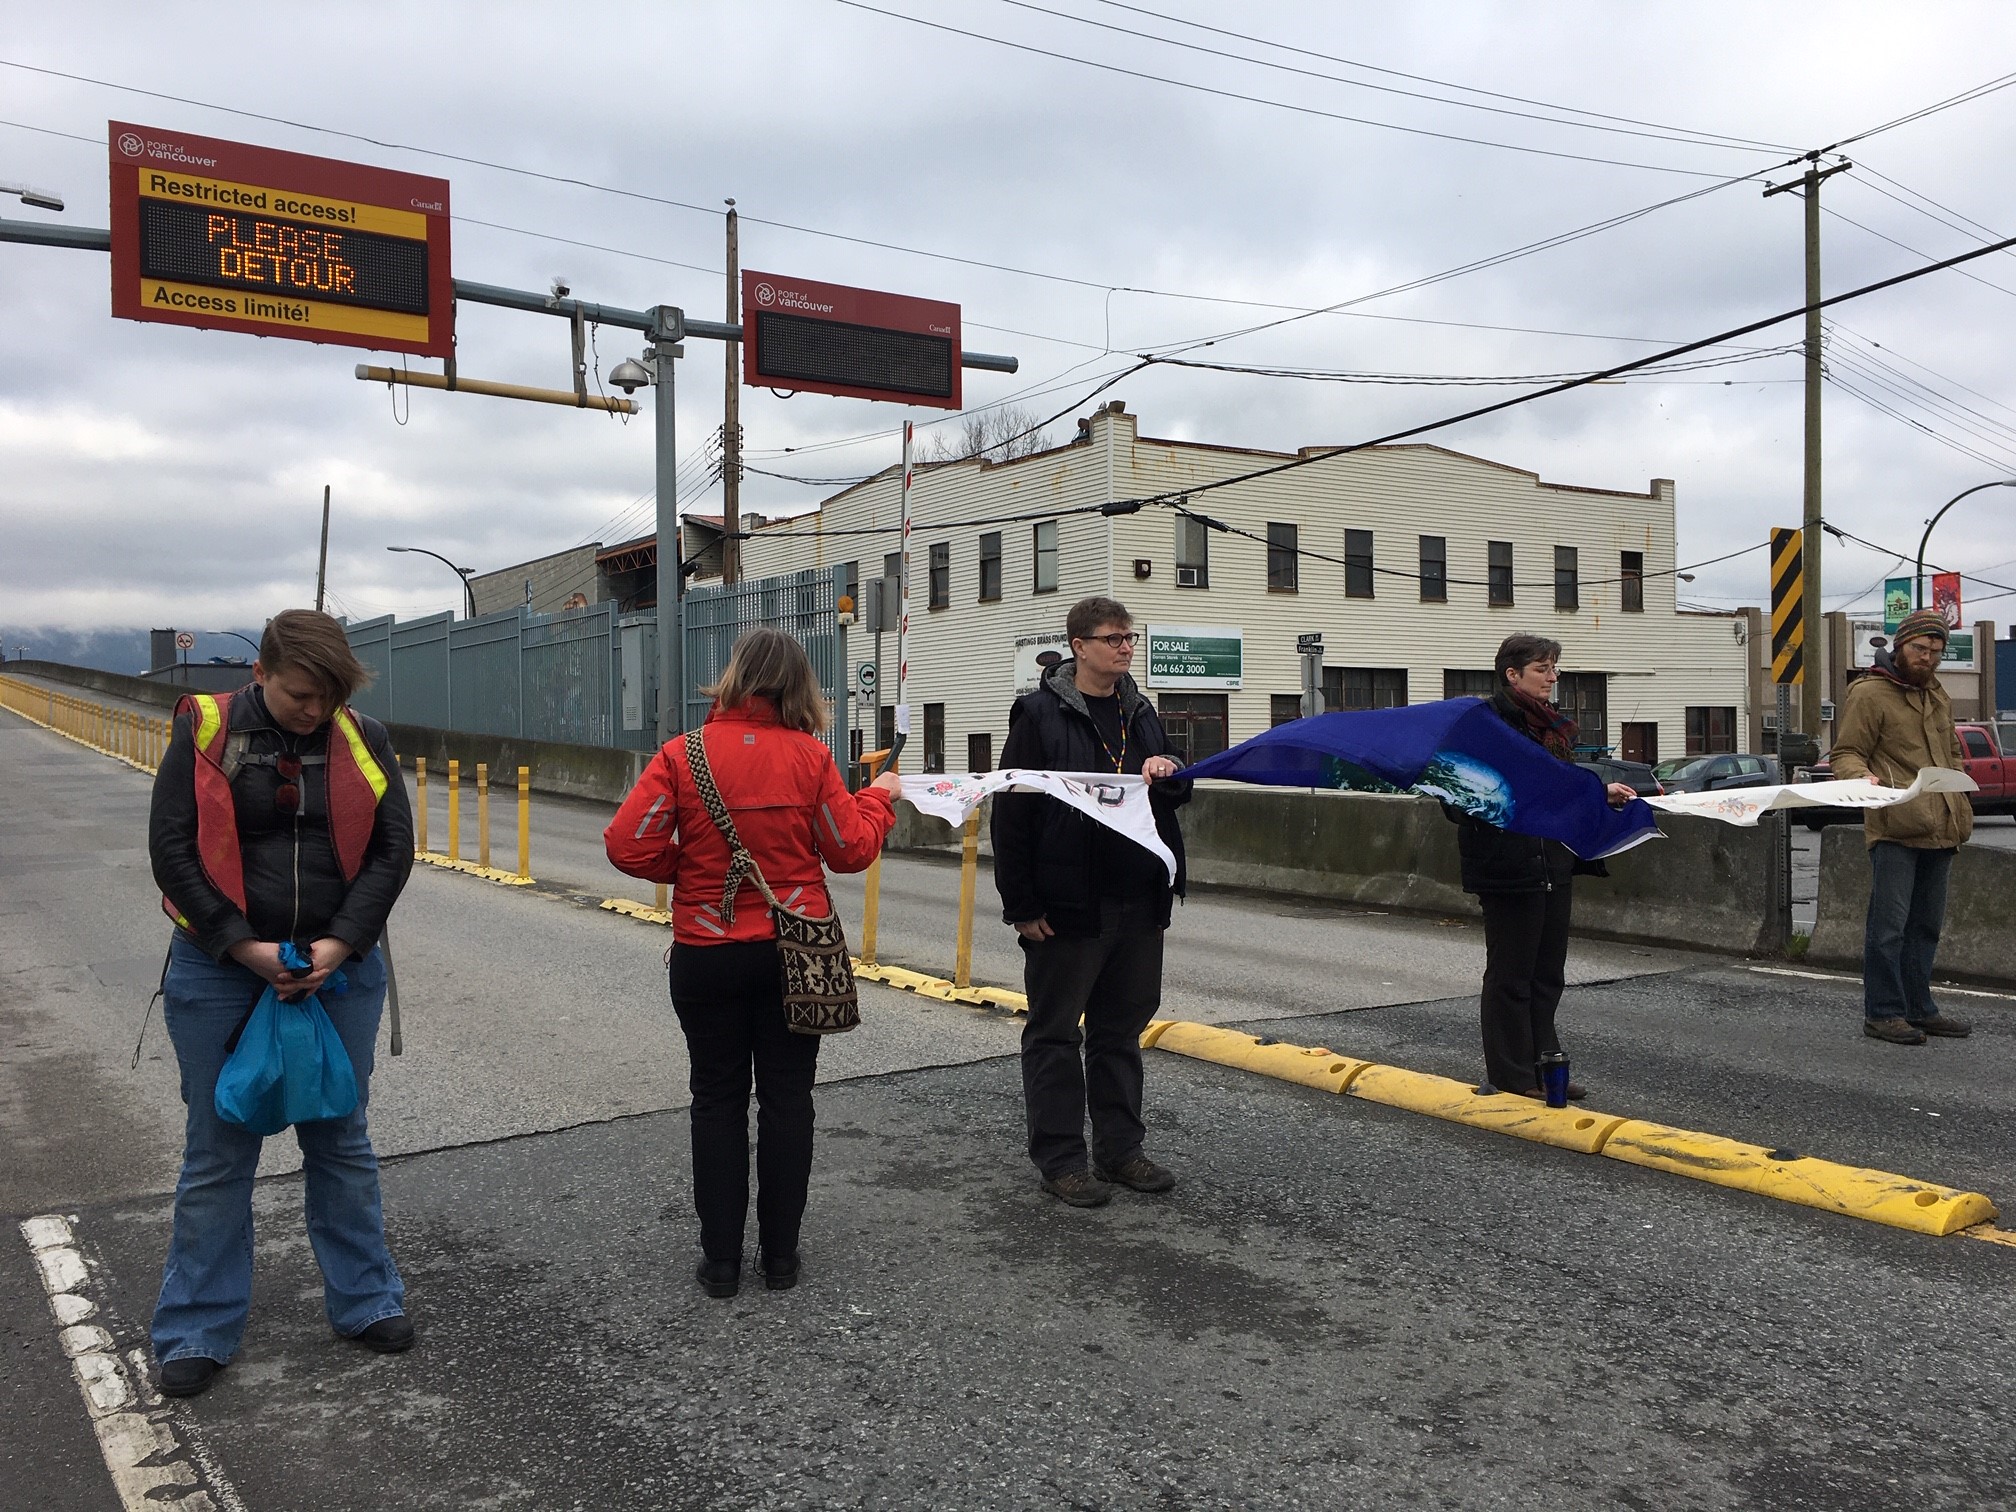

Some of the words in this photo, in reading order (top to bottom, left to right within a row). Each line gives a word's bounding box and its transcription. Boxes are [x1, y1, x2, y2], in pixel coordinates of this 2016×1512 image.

[147, 140, 173, 152] PORT
[174, 145, 184, 154] of
[147, 149, 217, 167] vancouver
[150, 174, 267, 209] Restricted
[274, 197, 356, 224] access!
[410, 197, 442, 211] Canada
[208, 214, 343, 262] PLEASE
[220, 247, 355, 294] DETOUR
[778, 289, 799, 300] PORT
[800, 293, 808, 301] of
[153, 286, 237, 313] Access
[244, 297, 310, 322] limité!
[778, 297, 834, 313] vancouver
[929, 323, 951, 334] Canada
[1015, 637, 1036, 647] HASTINGS
[1037, 635, 1051, 645] BRASS
[1152, 640, 1169, 651] FOR
[1170, 641, 1190, 652] SALE
[1300, 635, 1315, 643] CLARK
[1152, 663, 1168, 673] 604
[1169, 664, 1184, 674] 662
[1186, 664, 1206, 674] 3000
